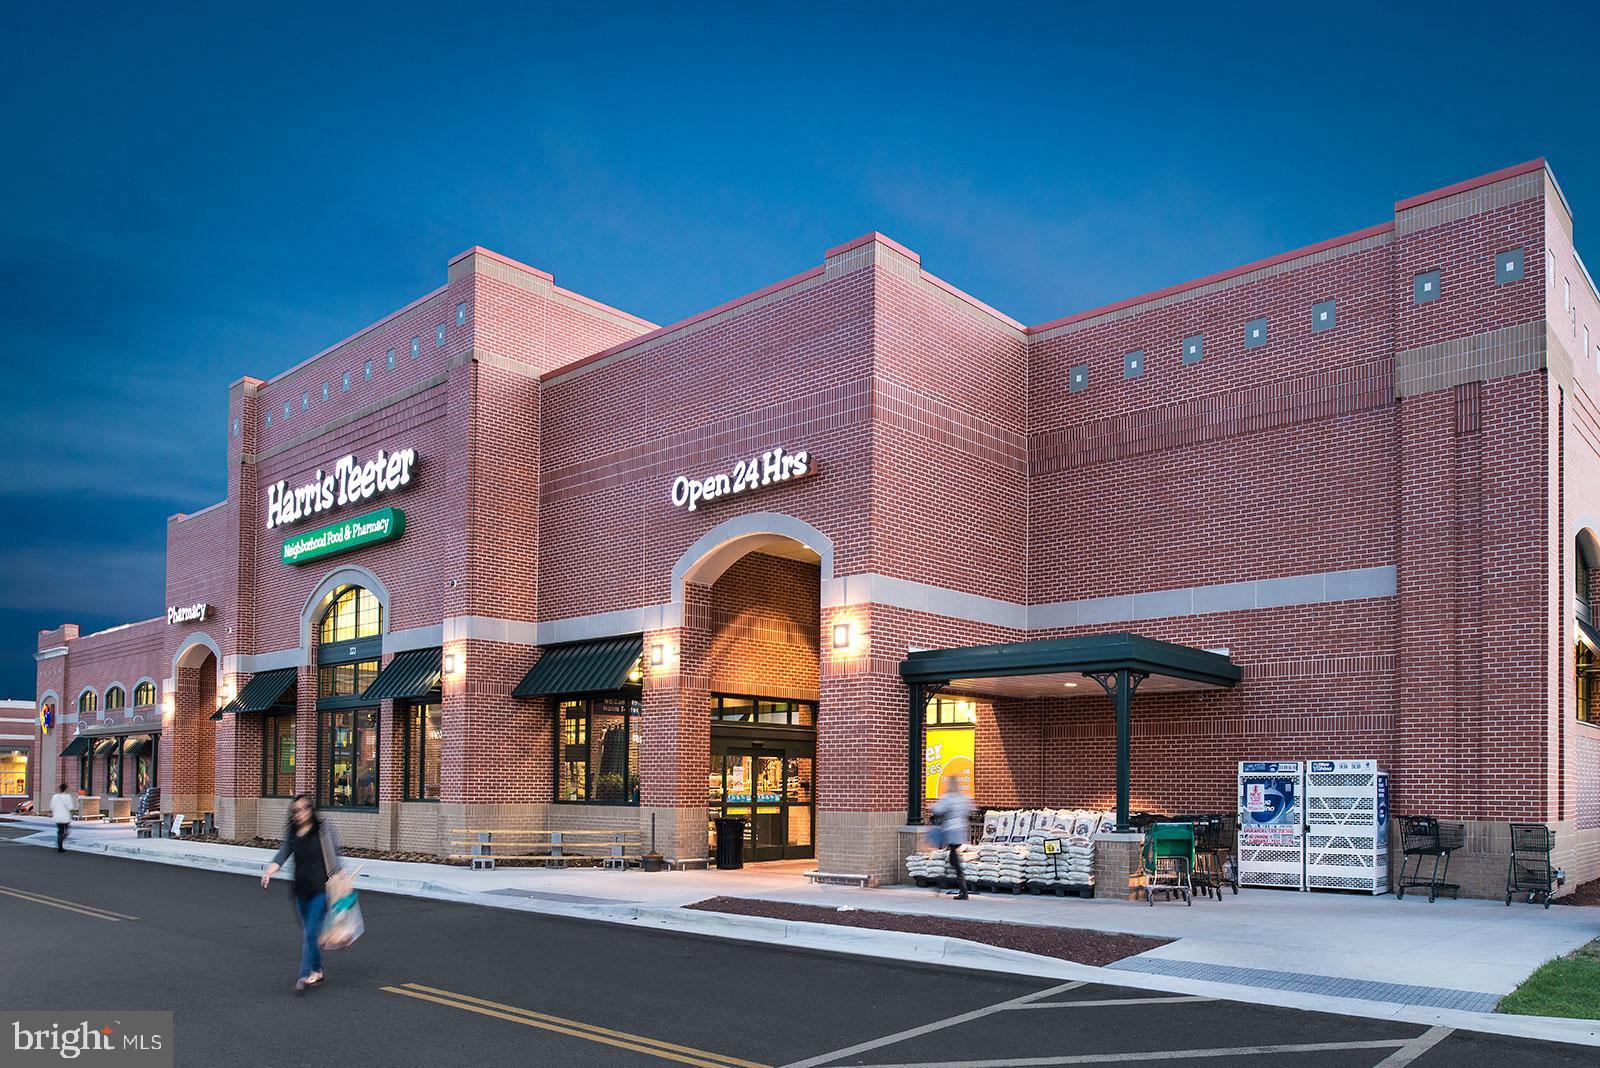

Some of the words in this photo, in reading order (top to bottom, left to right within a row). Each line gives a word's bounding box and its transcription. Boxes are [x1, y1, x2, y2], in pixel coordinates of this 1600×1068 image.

[267, 469, 334, 529] Harris
[336, 448, 414, 506] Teeter
[671, 474, 730, 512] Open
[733, 458, 760, 493] 24
[762, 447, 808, 485] Hrs
[284, 533, 327, 560] Neighborhood
[327, 526, 343, 546] Food
[344, 524, 352, 539] &
[352, 517, 390, 538] Pharmacy
[167, 602, 206, 625] Pharmacy
